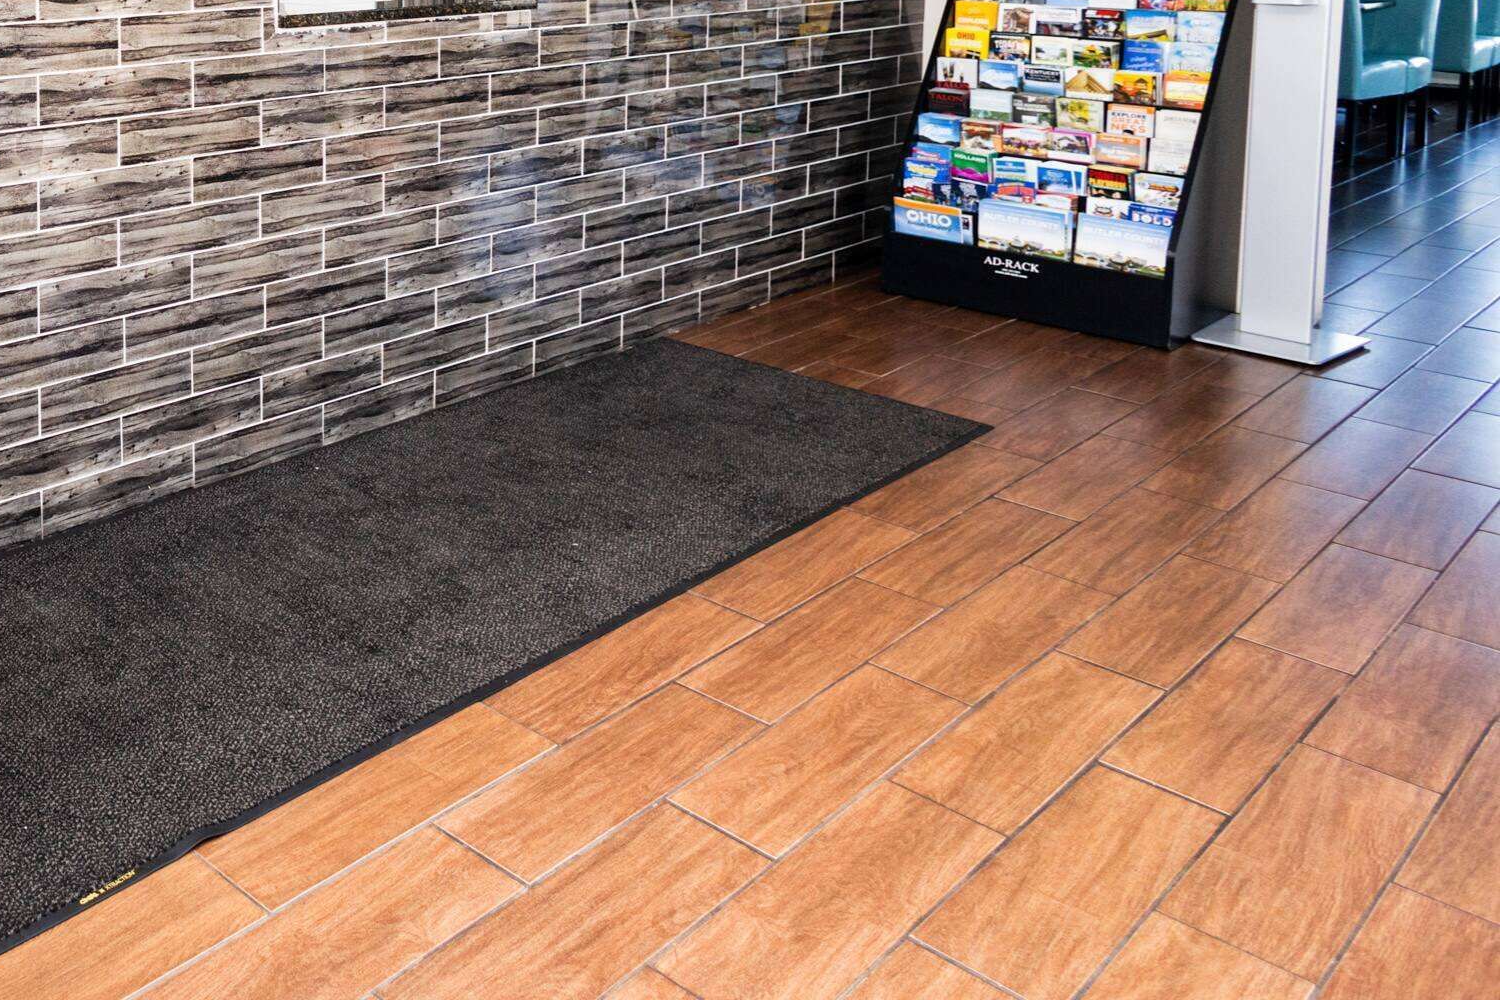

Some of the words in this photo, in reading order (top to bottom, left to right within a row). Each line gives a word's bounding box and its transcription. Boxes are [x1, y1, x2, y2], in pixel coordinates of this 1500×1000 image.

[1025, 68, 1060, 77] KENTUCKY
[930, 93, 964, 103] TALON
[1111, 111, 1147, 120] EXPLORE
[1111, 118, 1146, 126] GREAT
[1111, 124, 1147, 133] NESS
[954, 152, 986, 164] HOLLAND
[906, 209, 952, 228] OHIO
[1132, 211, 1173, 226] BOLD
[983, 256, 1040, 274] AD-RACK
